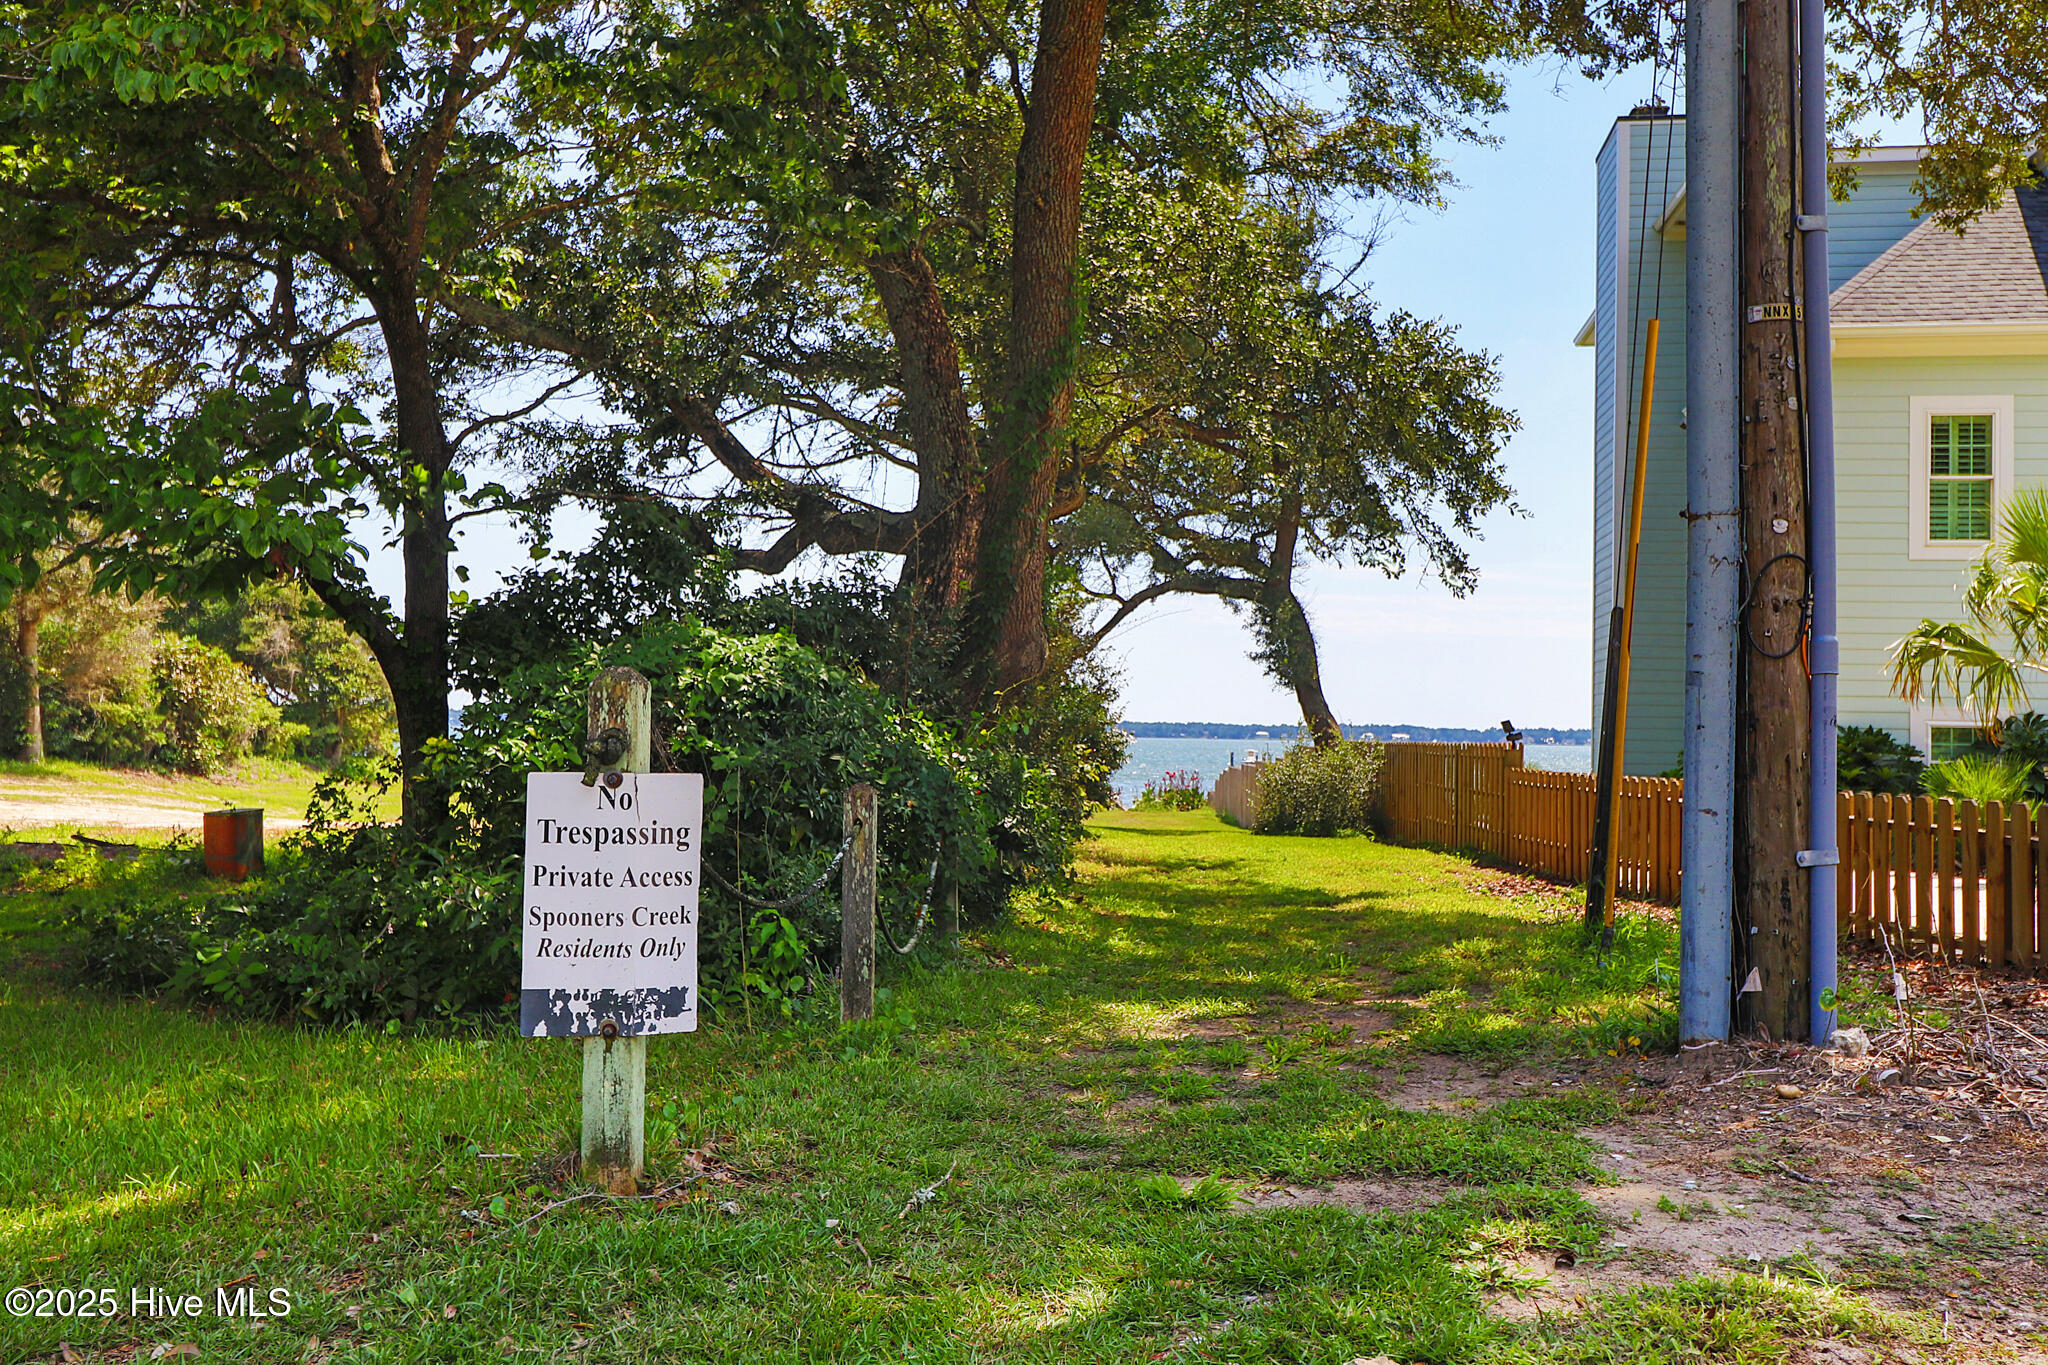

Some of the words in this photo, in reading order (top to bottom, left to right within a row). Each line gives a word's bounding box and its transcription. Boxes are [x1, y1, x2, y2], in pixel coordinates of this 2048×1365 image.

[596, 785, 632, 810] No
[537, 819, 691, 851] Trespassing
[532, 865, 613, 888] Private
[619, 867, 693, 888] Access
[529, 906, 624, 931] Spooners
[632, 906, 692, 927] Creek
[536, 937, 632, 959] Residents
[640, 937, 686, 961] Only
